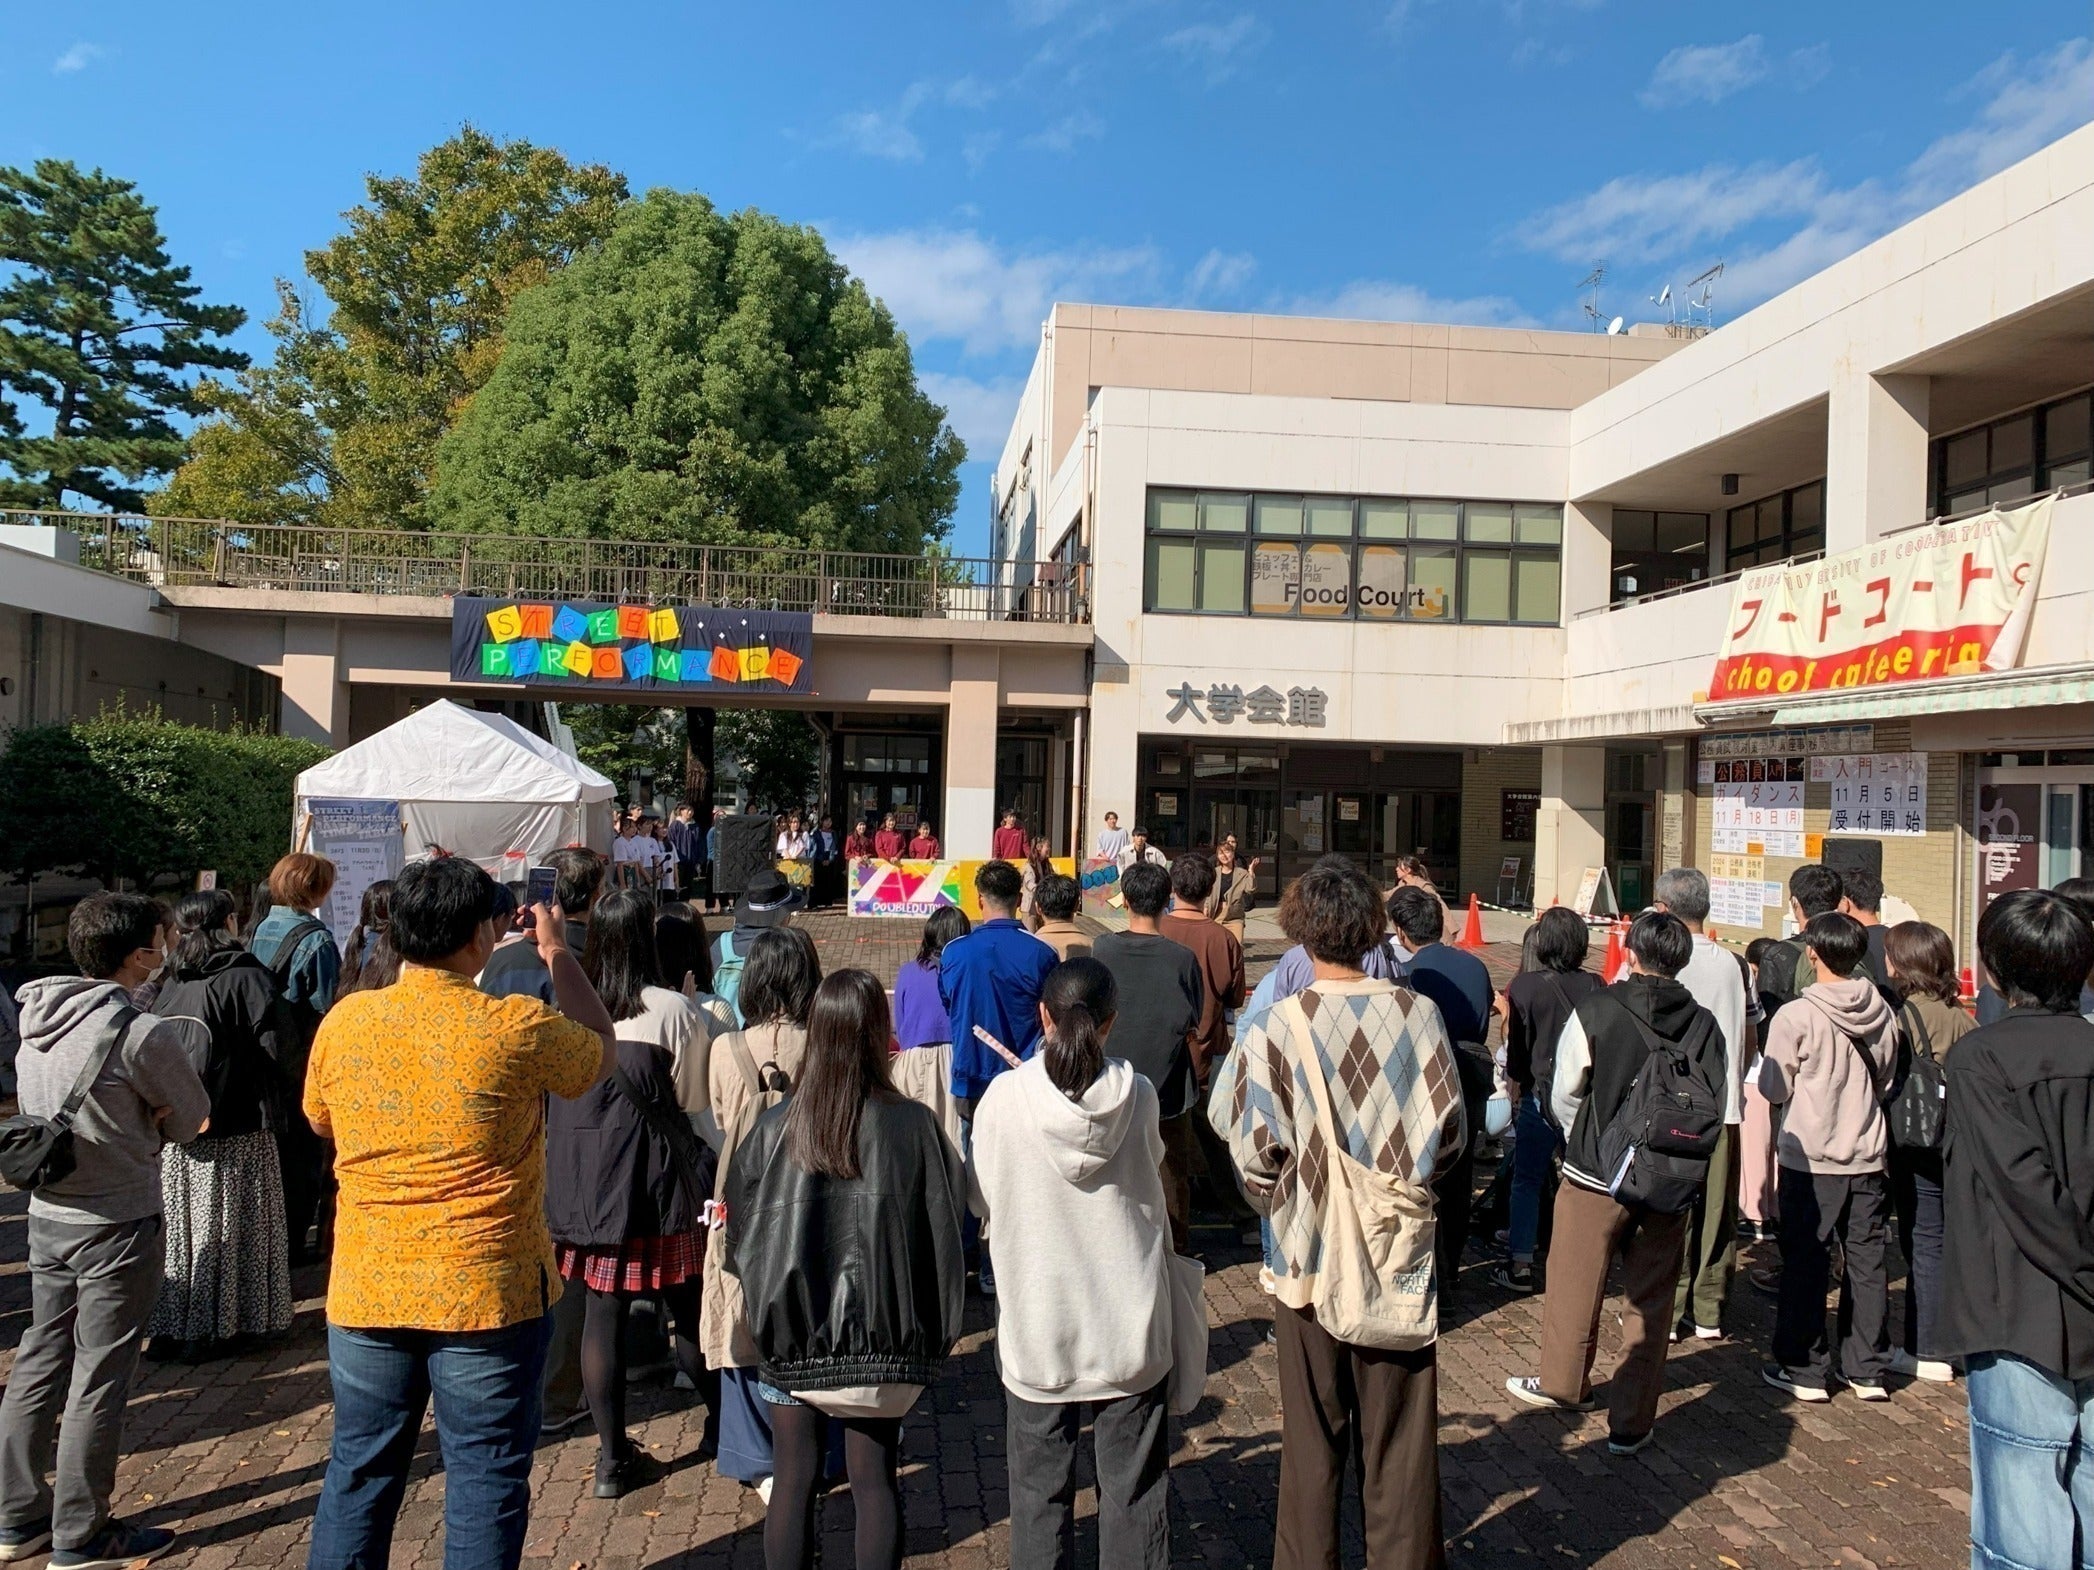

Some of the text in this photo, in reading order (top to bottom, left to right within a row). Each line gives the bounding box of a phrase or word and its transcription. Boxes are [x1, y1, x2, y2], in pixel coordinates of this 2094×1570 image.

[1871, 549, 1888, 568] OF
[1284, 583, 1426, 607] Food Court
[1732, 552, 1993, 643] フードコート
[494, 606, 674, 640] STREET
[487, 645, 795, 679] PERFORMANCE
[1166, 682, 1329, 728] 大学会館
[1835, 757, 1916, 779] 入門コース
[1716, 784, 1800, 802] ガイダンス
[1835, 785, 1919, 803] 11月5日
[314, 807, 353, 815] STREET
[322, 814, 397, 823] PERFORMANCE
[1835, 810, 1920, 833] 受付開始
[2013, 834, 2034, 842] FLOOR
[1393, 1274, 1430, 1287] NORTH
[1402, 1285, 1431, 1297] FACE
